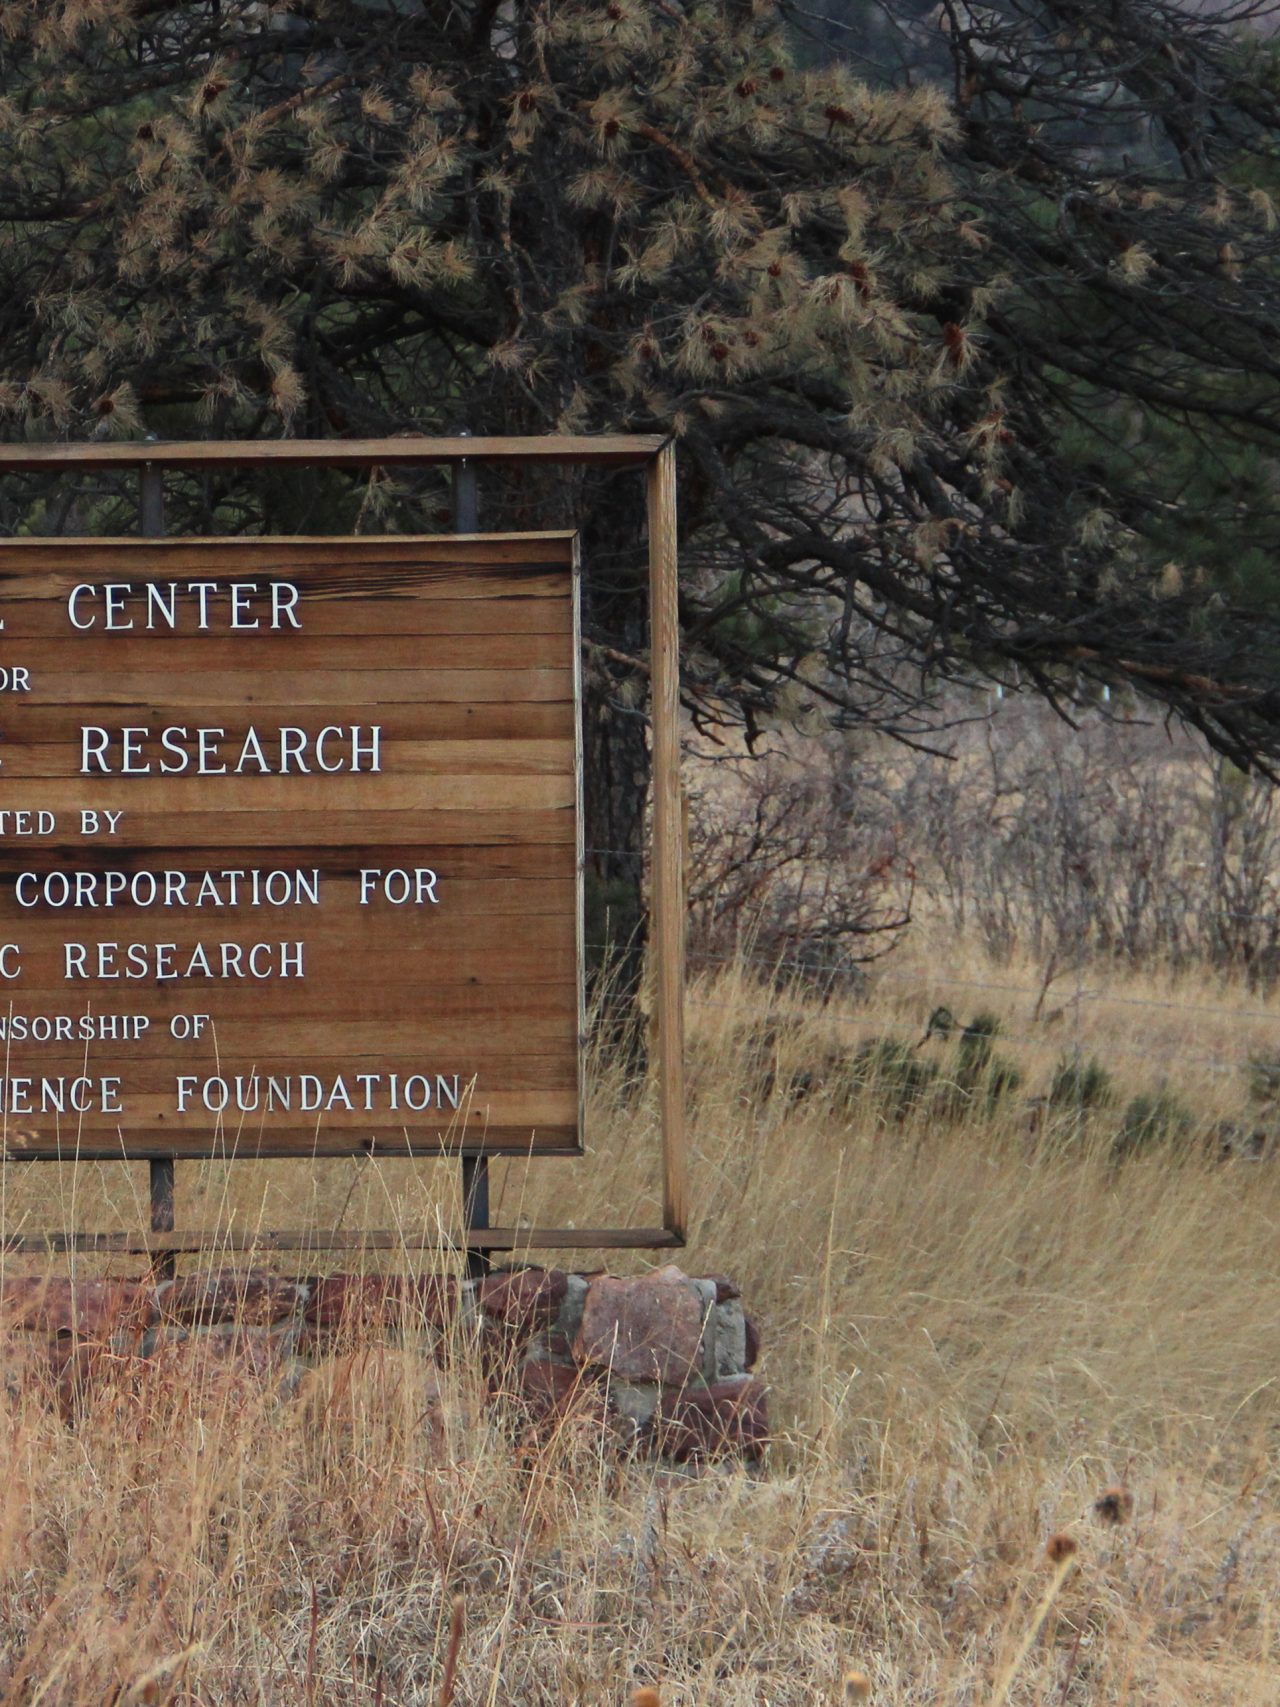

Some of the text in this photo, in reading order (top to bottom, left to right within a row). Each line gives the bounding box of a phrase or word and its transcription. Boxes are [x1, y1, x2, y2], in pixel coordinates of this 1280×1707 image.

[68, 582, 303, 630] CENTER
[79, 725, 382, 774] RESEARCH
[80, 809, 124, 835] BY
[15, 869, 320, 907] CORPORATION
[359, 868, 440, 905] FOR
[63, 941, 305, 979] RESEARCH
[170, 1014, 210, 1039] OF
[175, 1073, 460, 1112] FOUNDATION
